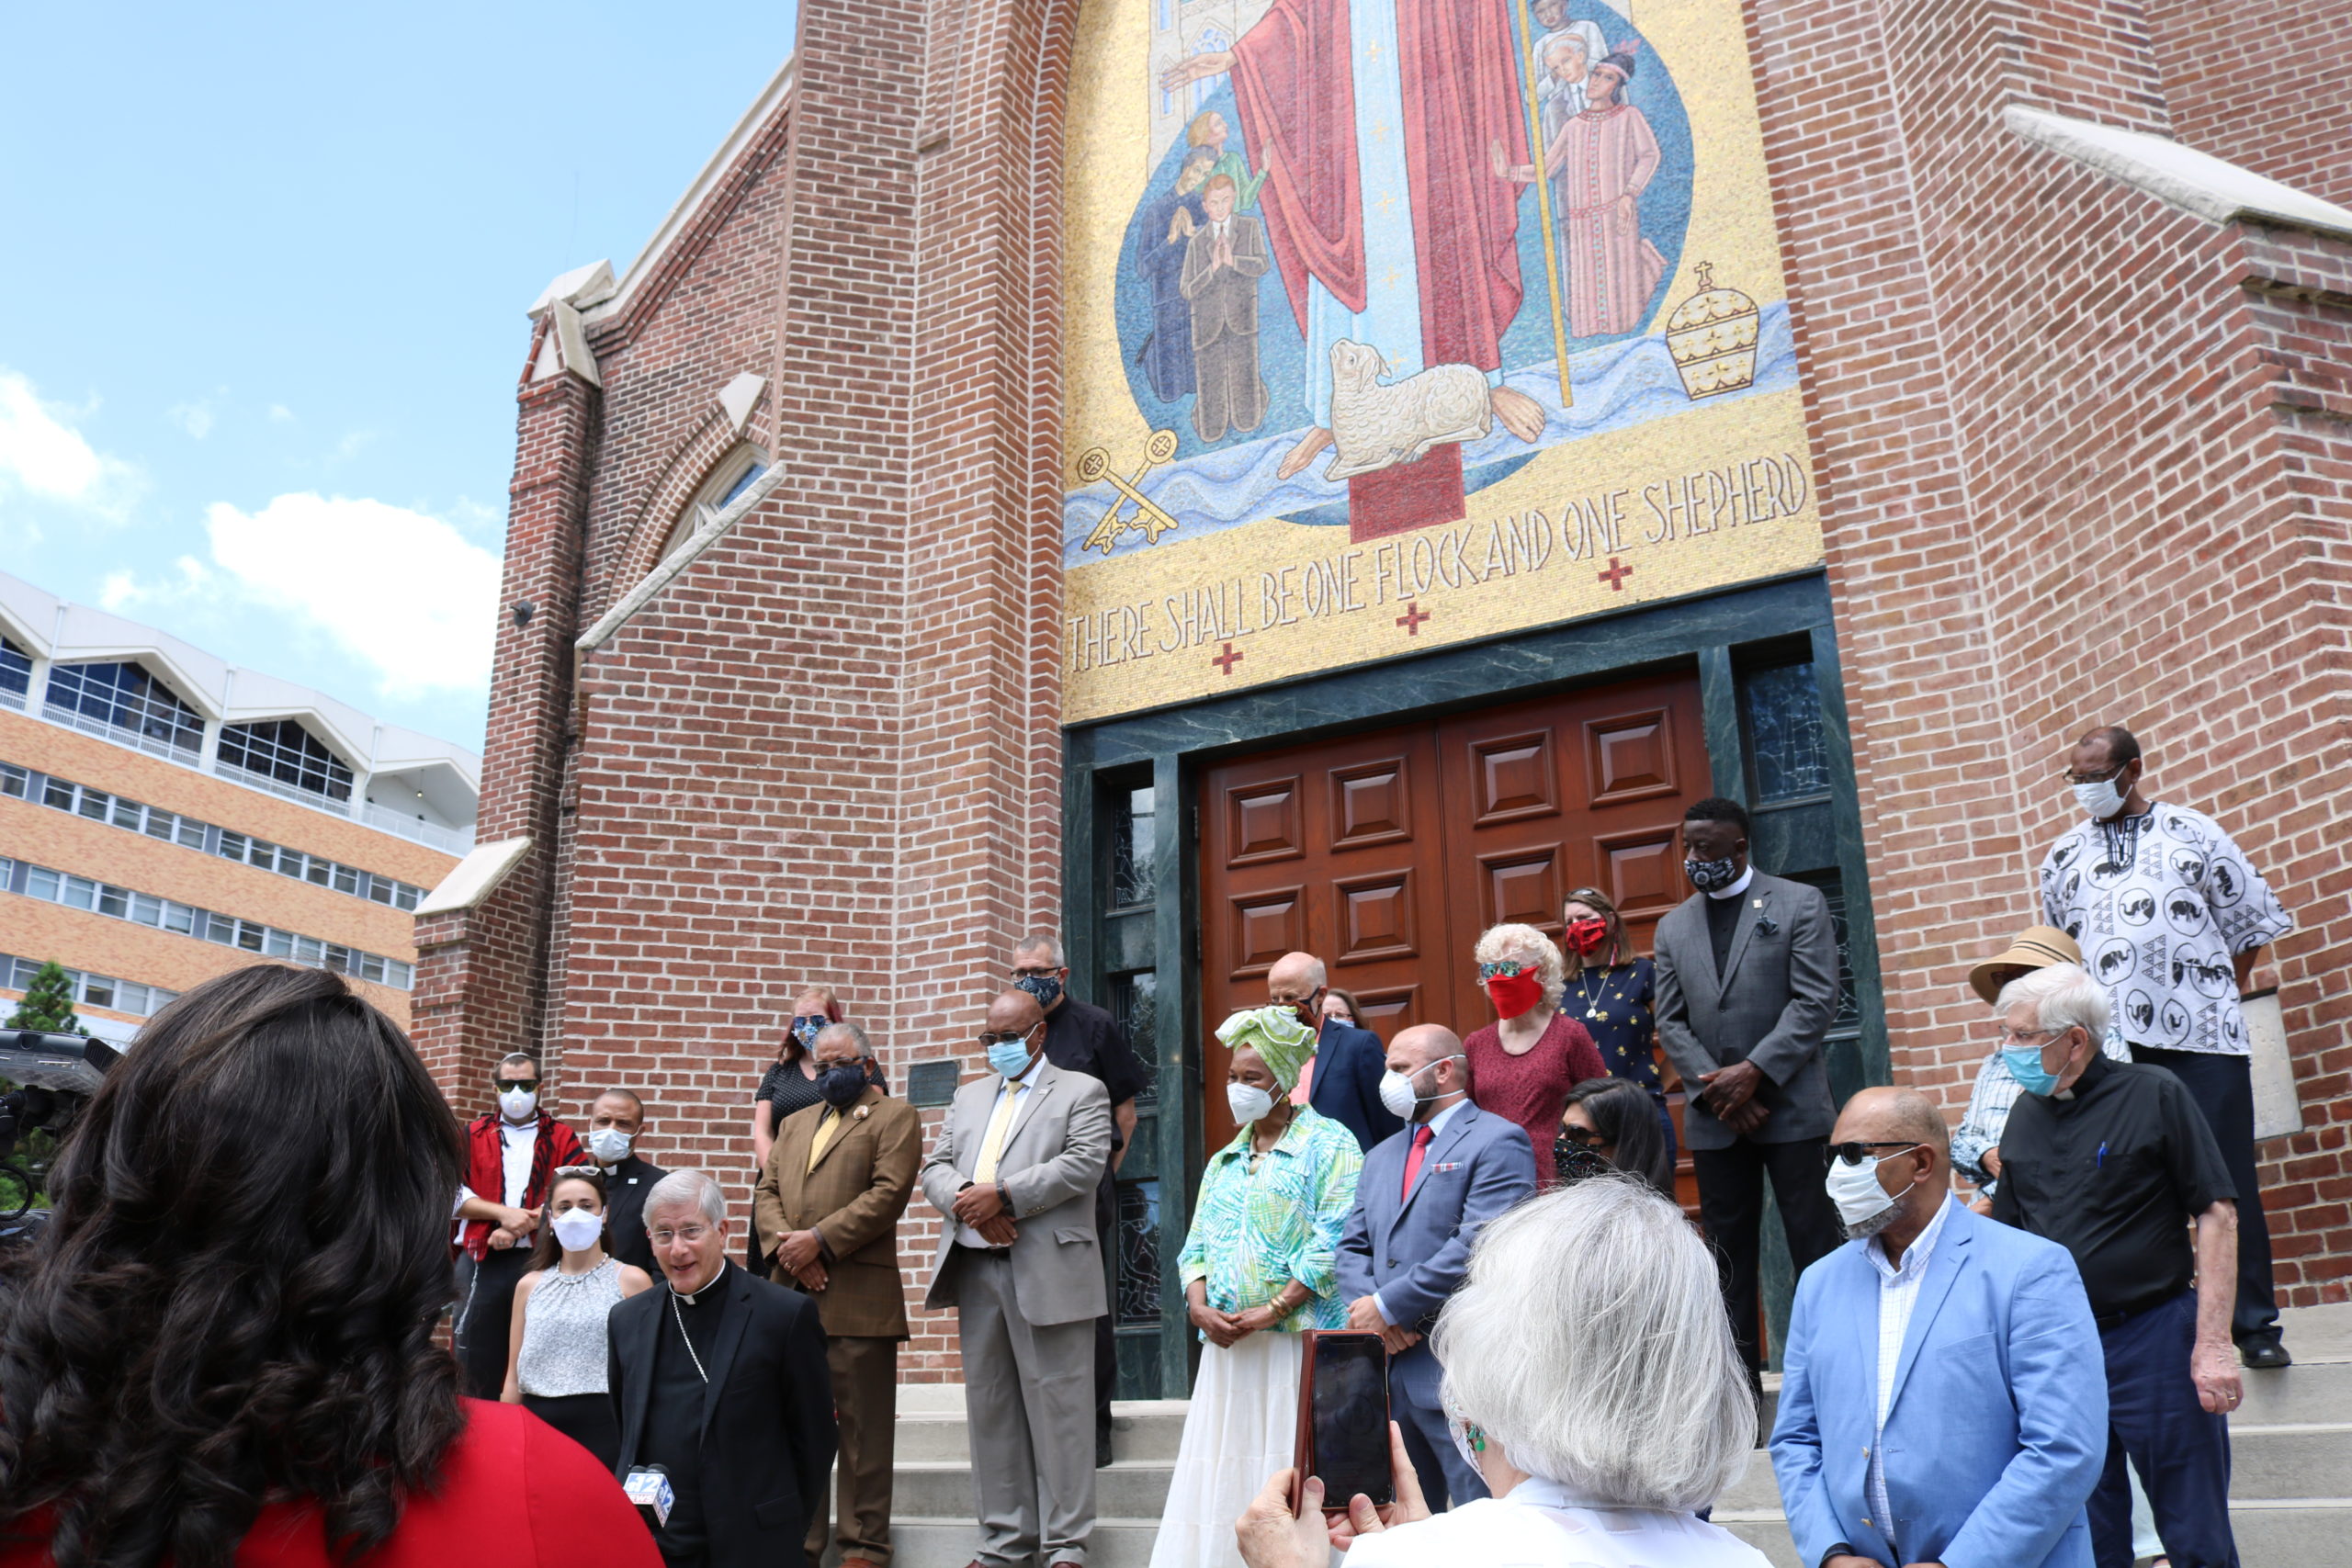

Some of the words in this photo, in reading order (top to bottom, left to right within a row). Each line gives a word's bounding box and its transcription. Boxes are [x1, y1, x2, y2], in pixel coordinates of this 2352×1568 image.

[1067, 599, 1153, 673] THERE
[1159, 579, 1253, 653] SHALL
[1261, 564, 1297, 630] BE
[1302, 550, 1366, 618] ONE
[1374, 524, 1479, 605] FLOCK
[1481, 509, 1553, 581] AND
[1561, 489, 1632, 561] ONE
[1639, 453, 1806, 545] SHEPHERD
